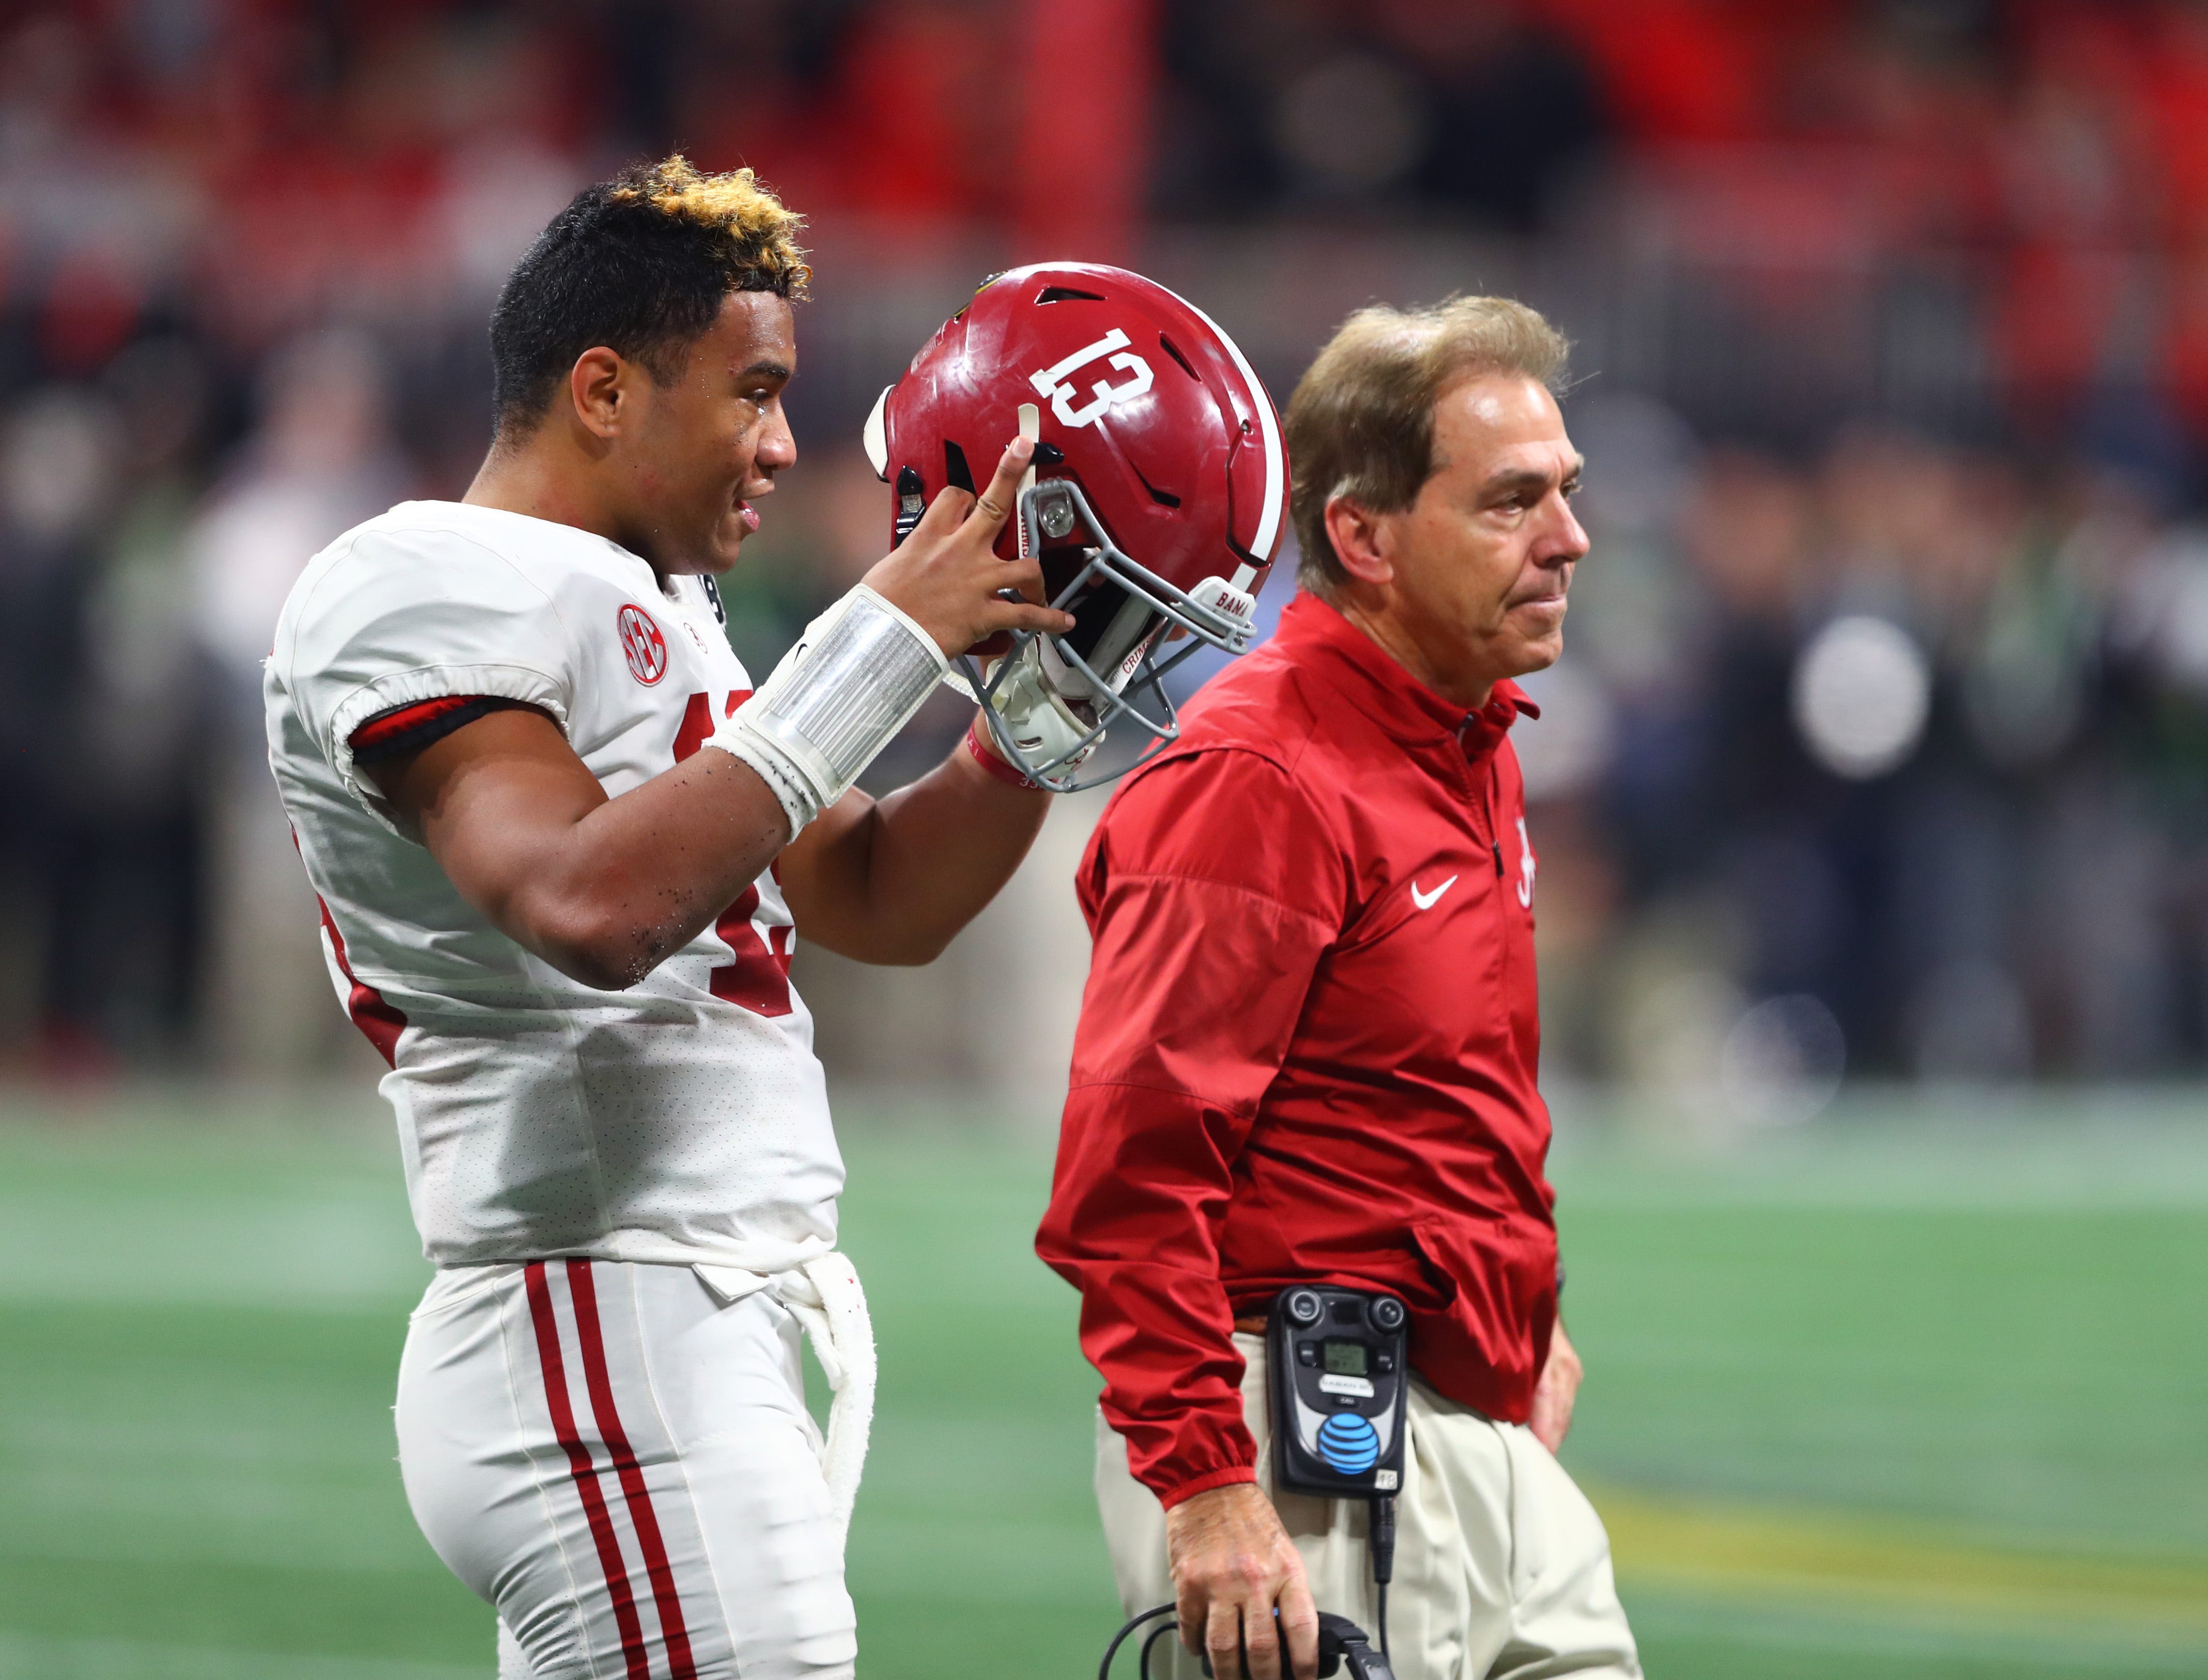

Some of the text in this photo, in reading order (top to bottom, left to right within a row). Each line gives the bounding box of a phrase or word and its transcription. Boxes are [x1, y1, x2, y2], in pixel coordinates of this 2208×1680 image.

[1029, 328, 1155, 428] 13
[1216, 591, 1249, 617] BAMA
[620, 608, 665, 680] SEC
